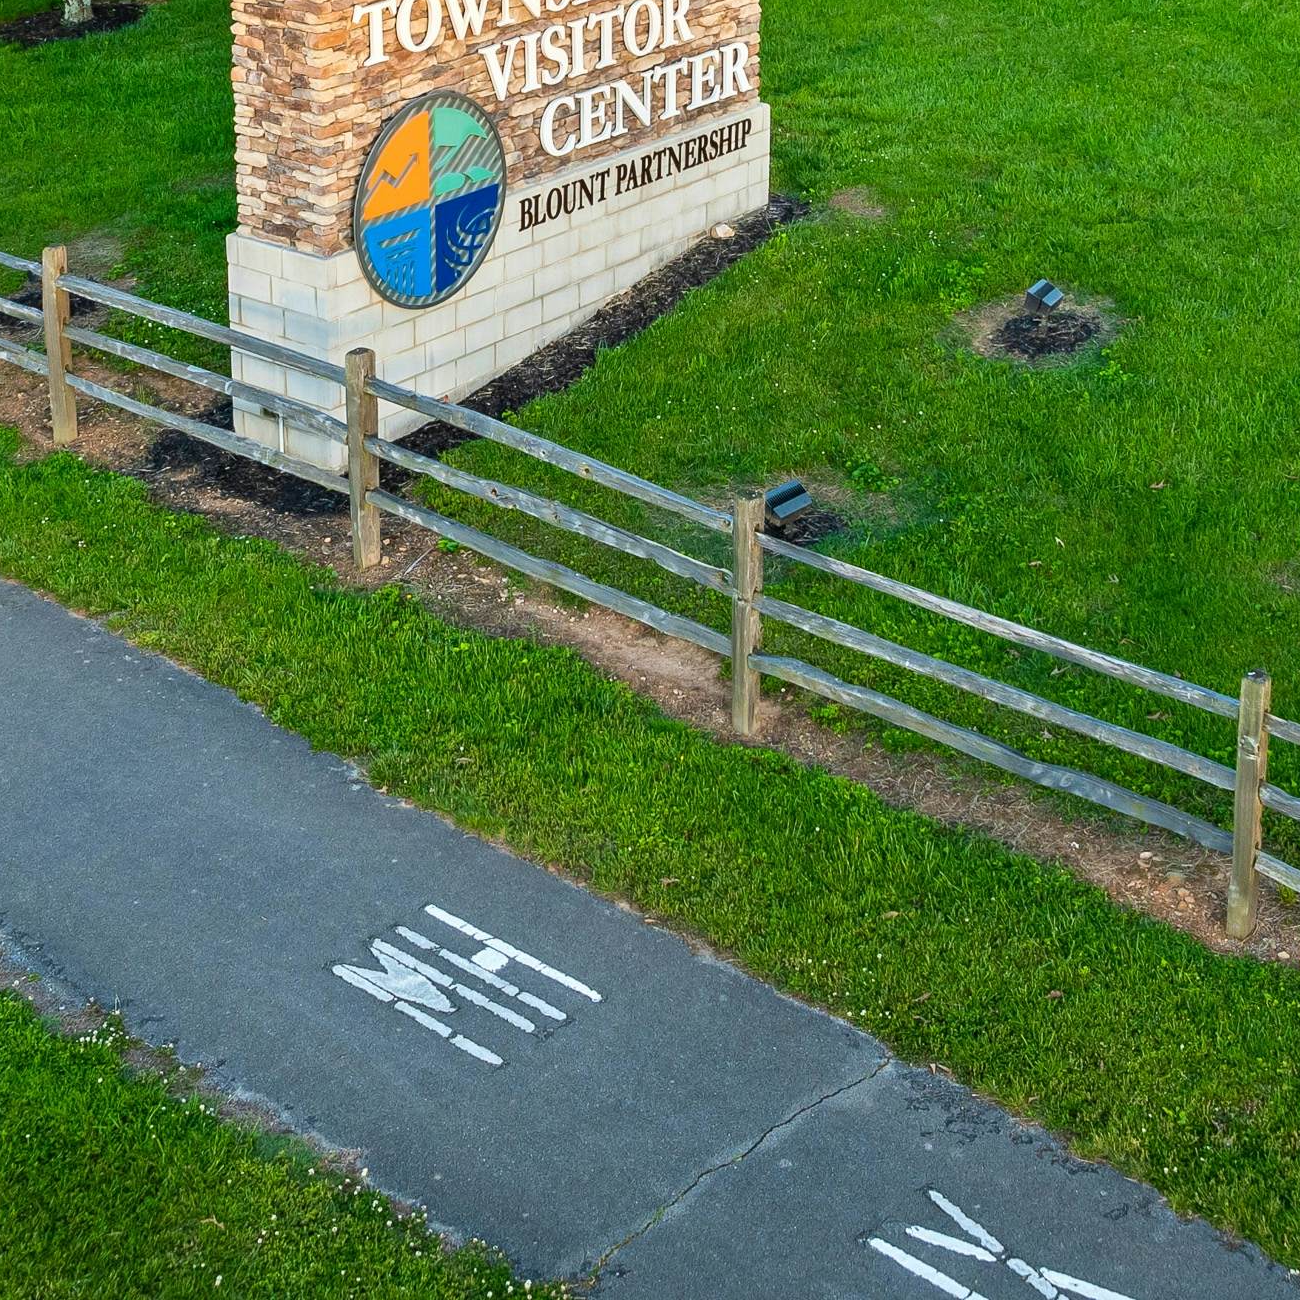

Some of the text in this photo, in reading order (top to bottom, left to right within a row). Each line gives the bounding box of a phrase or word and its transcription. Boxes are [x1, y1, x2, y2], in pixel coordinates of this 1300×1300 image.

[540, 42, 752, 157] CENTER
[519, 118, 752, 232] BLOUNT PARTNERSHIP
